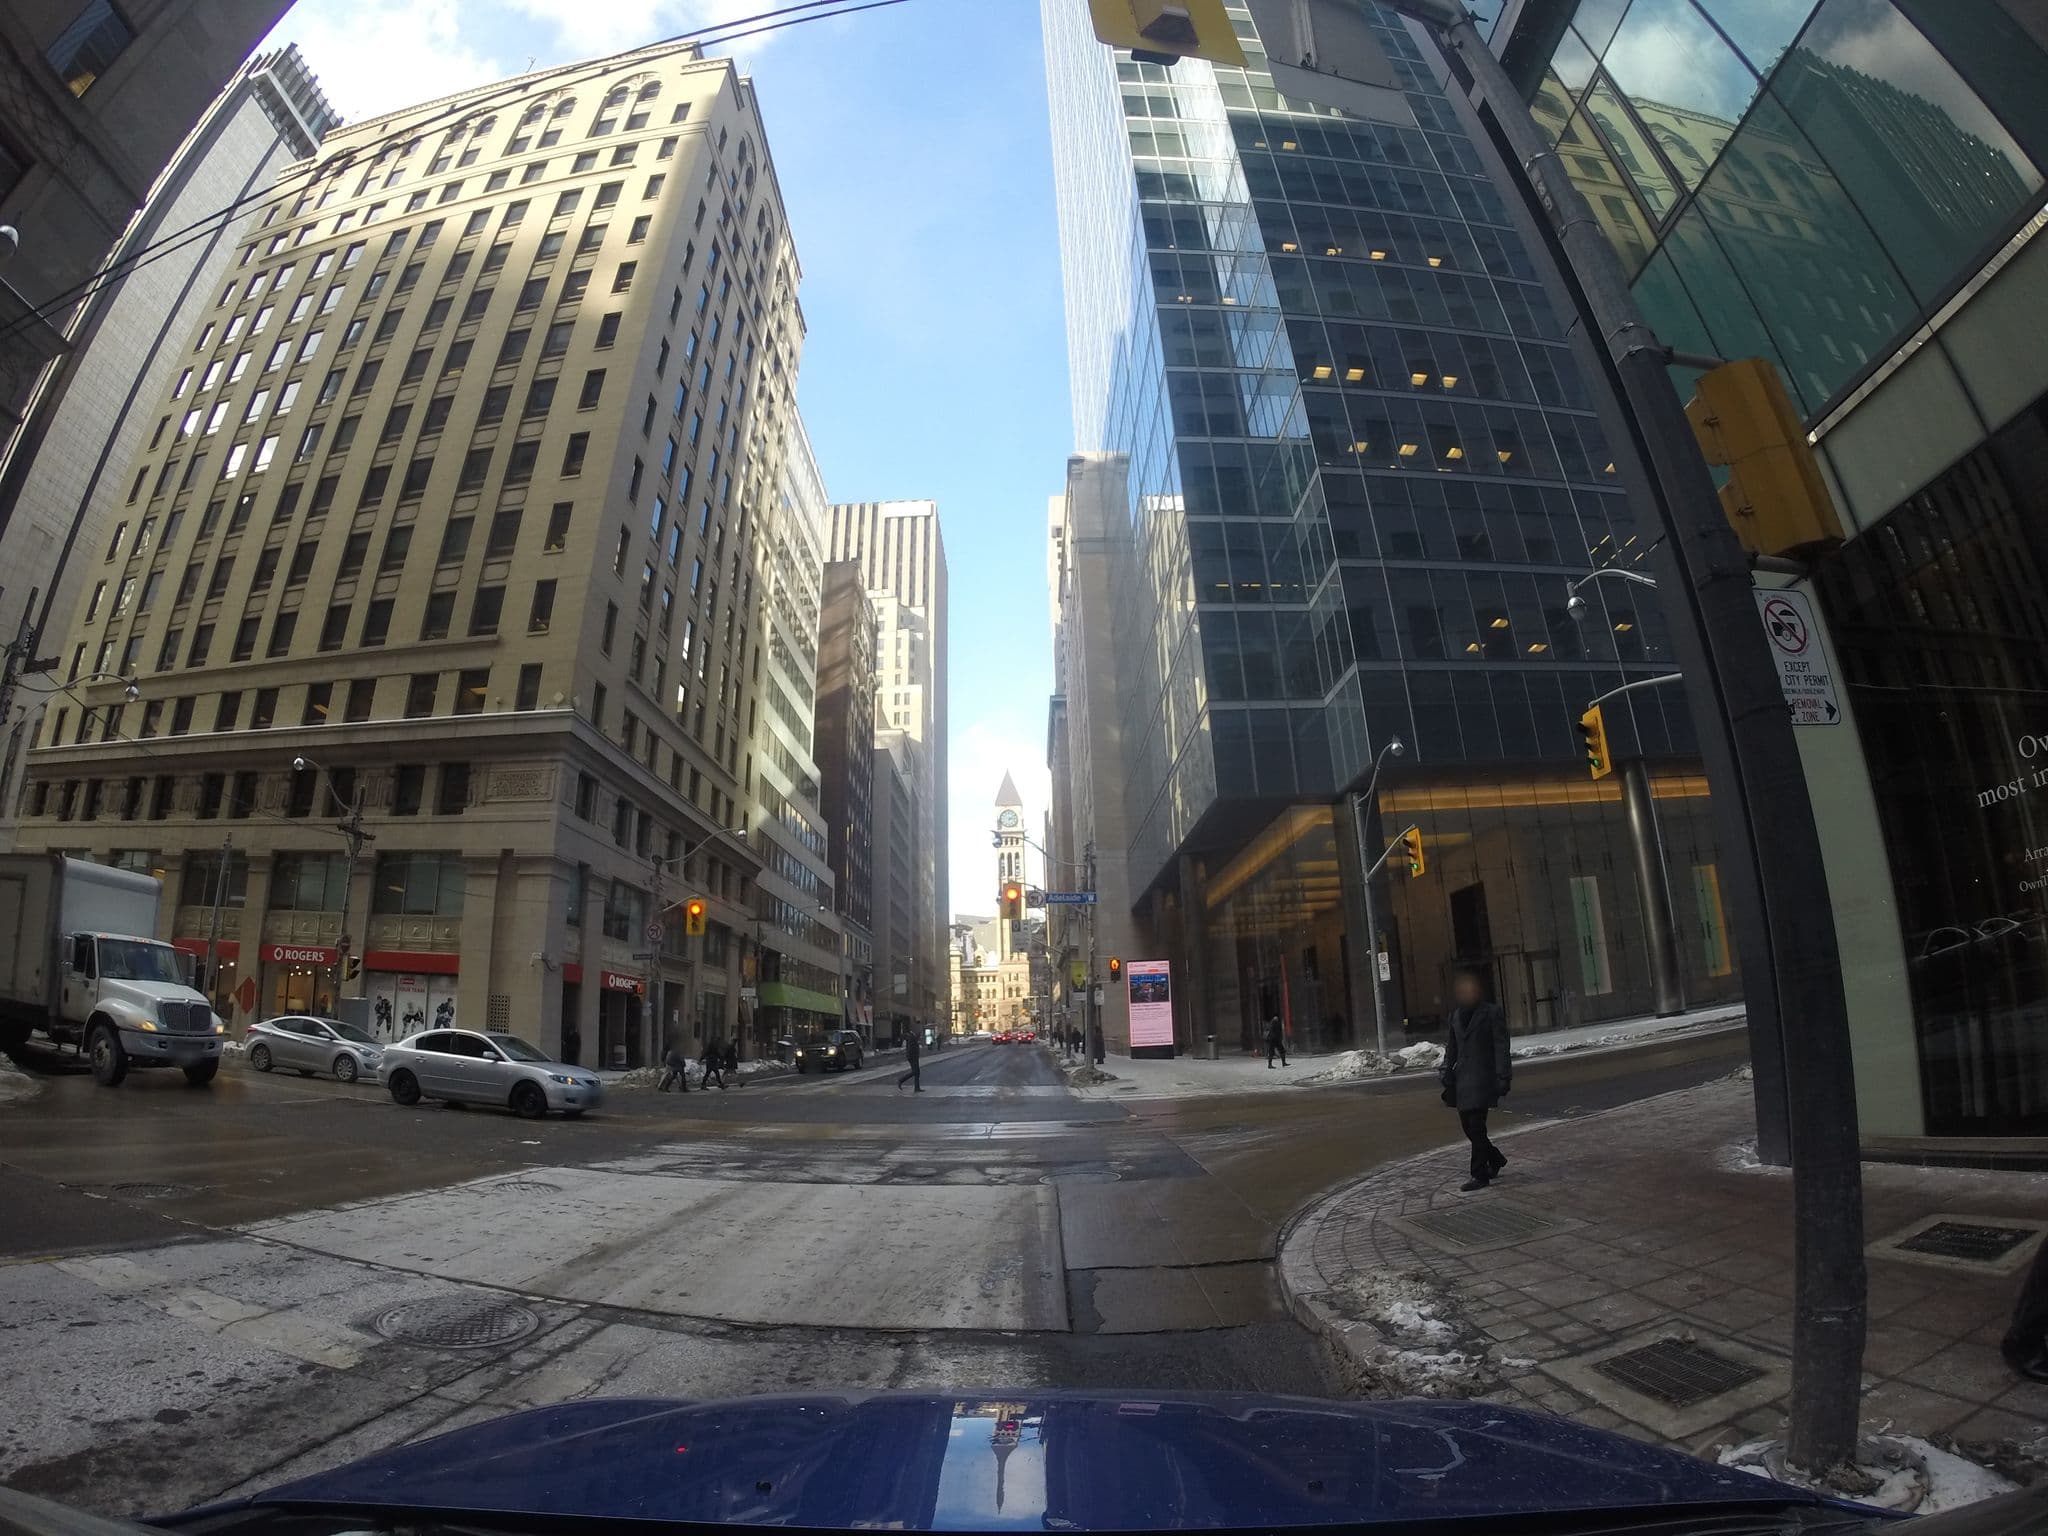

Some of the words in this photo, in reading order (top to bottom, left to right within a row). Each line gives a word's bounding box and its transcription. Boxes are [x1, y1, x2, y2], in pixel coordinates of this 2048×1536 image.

[1784, 661, 1811, 673] EXCEPT
[1785, 674, 1801, 686] CITY
[1804, 674, 1829, 686] PERMIT
[1791, 698, 1823, 709] REMOVAL
[1801, 711, 1820, 722] ZONE
[1977, 776, 2026, 808] most
[1048, 893, 1082, 902] Adelaide
[1087, 894, 1095, 902] W
[285, 949, 325, 962] ROGERS
